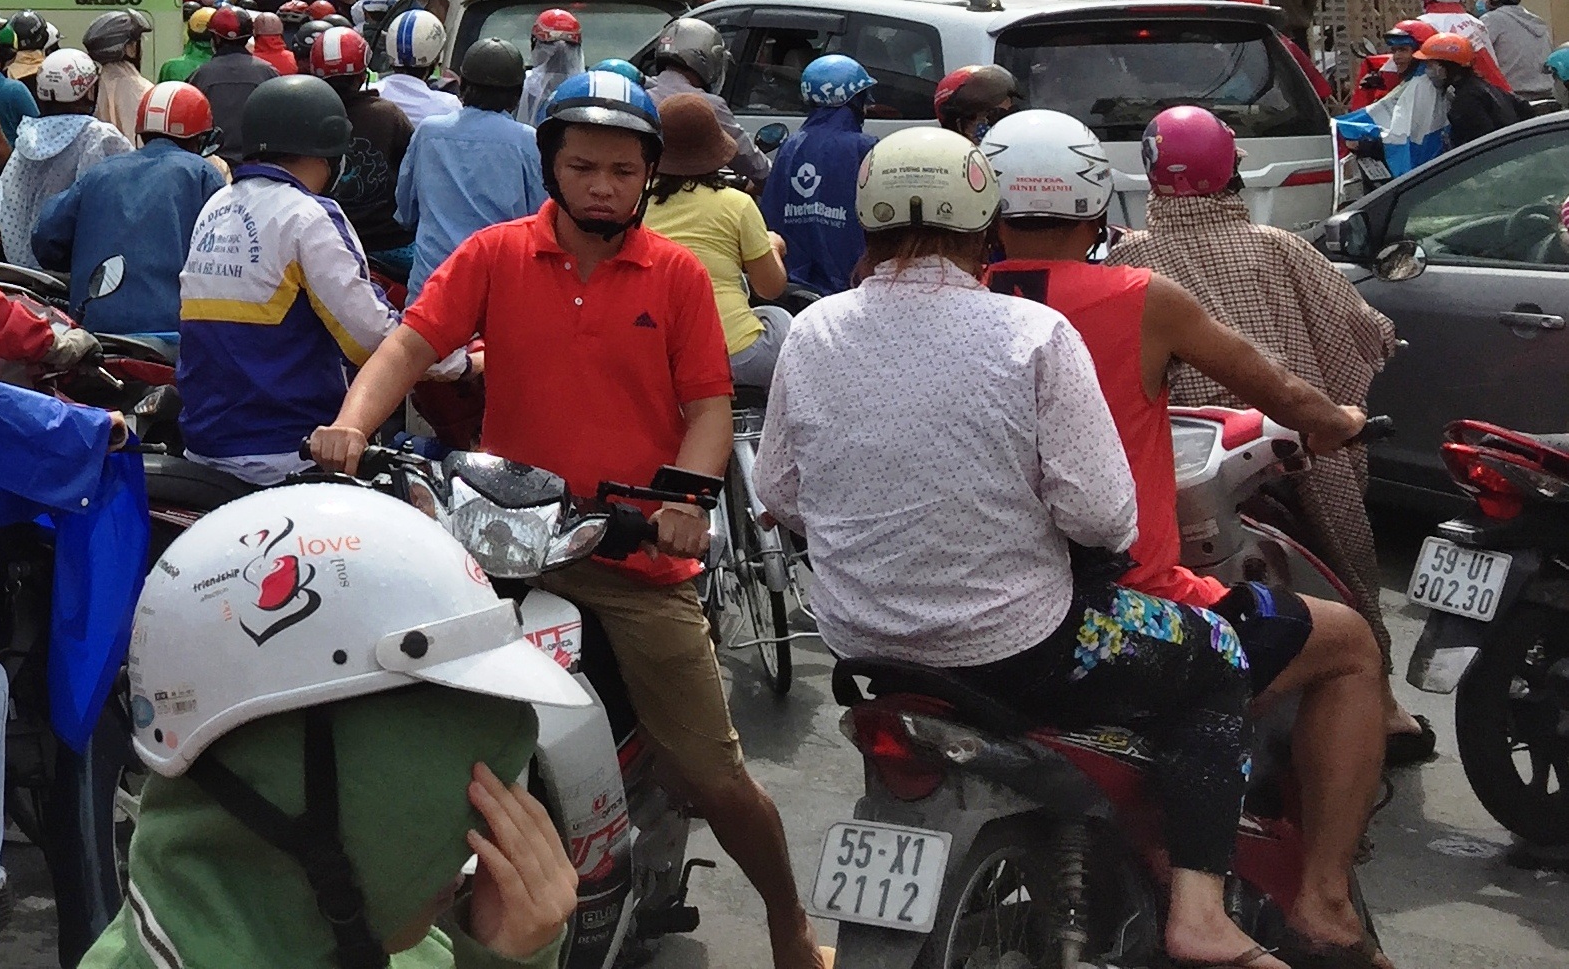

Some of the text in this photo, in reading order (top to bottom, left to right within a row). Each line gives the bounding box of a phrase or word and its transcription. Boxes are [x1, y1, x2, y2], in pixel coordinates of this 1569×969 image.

[297, 534, 362, 557] love
[1431, 545, 1494, 583] 59-U1
[192, 567, 240, 593] friendship
[330, 557, 350, 588] soul
[1414, 573, 1495, 615] 302.30
[837, 828, 926, 876] 55-X1
[825, 871, 920, 922] 2112
